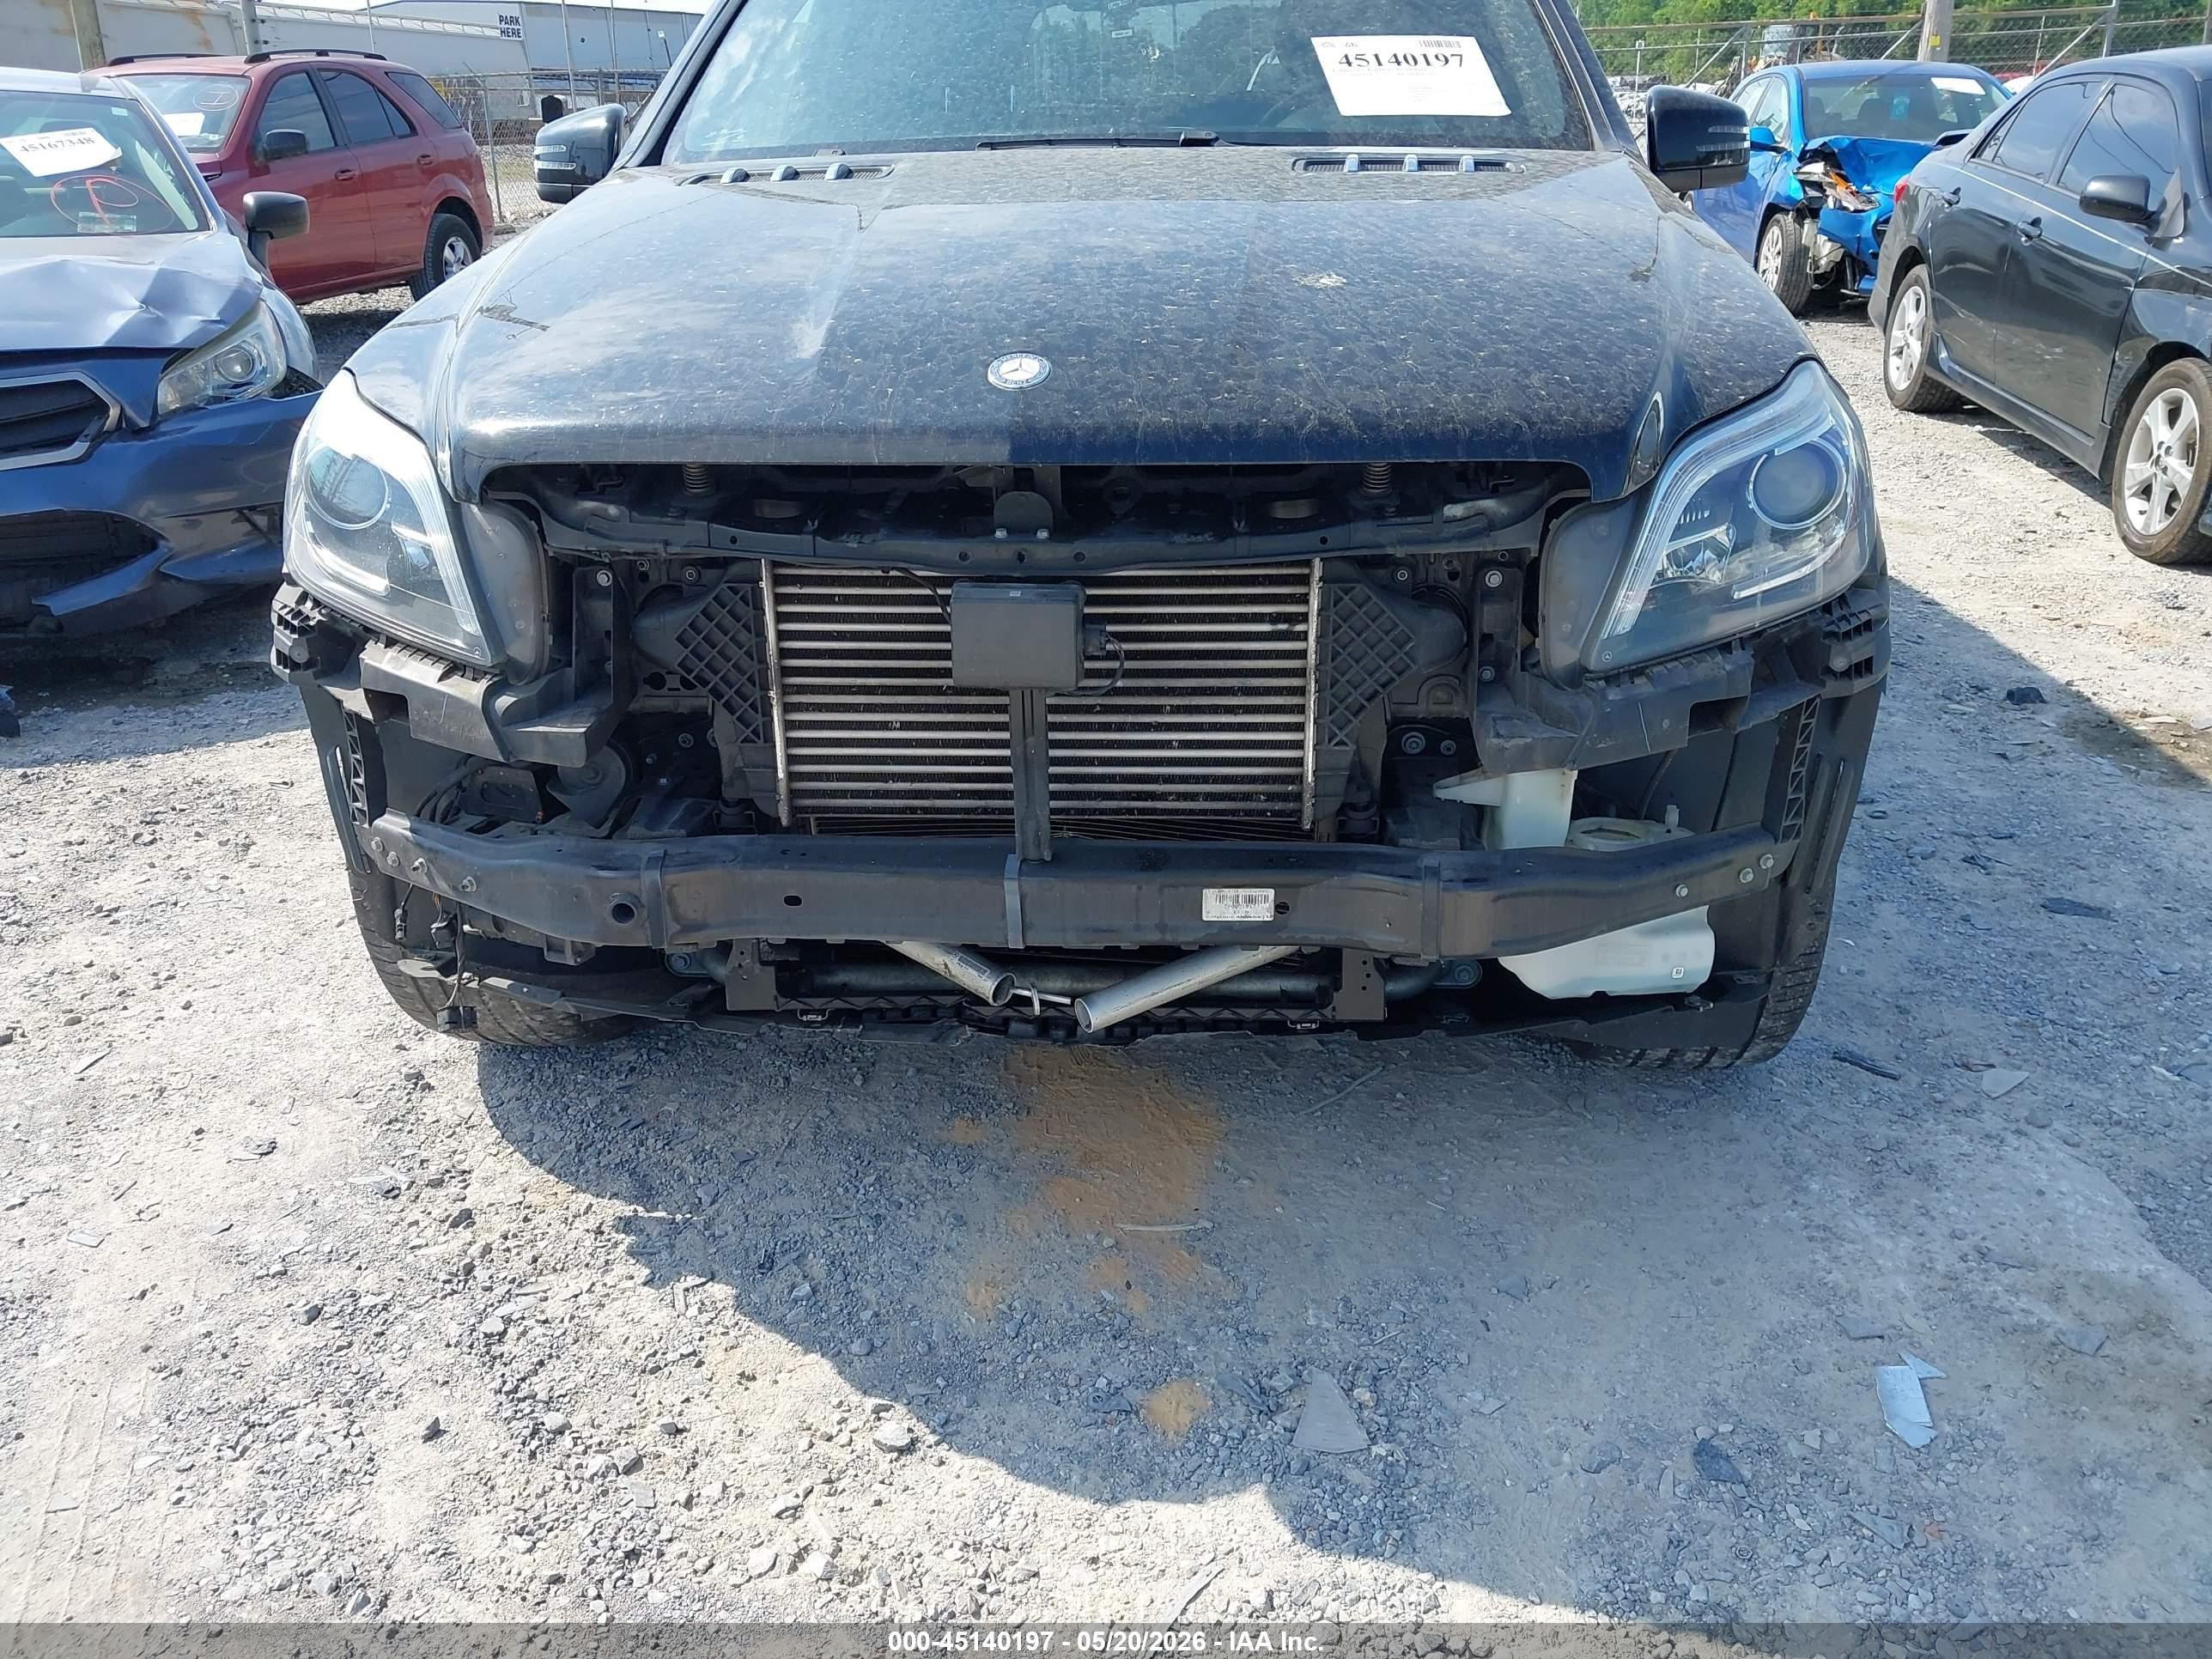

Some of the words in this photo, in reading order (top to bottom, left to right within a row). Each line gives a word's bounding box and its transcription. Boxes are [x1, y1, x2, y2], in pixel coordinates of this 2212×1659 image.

[498, 15, 520, 27] PARK
[500, 27, 522, 38] HERE
[1339, 52, 1463, 68] 45140197
[20, 136, 97, 154] 45167348
